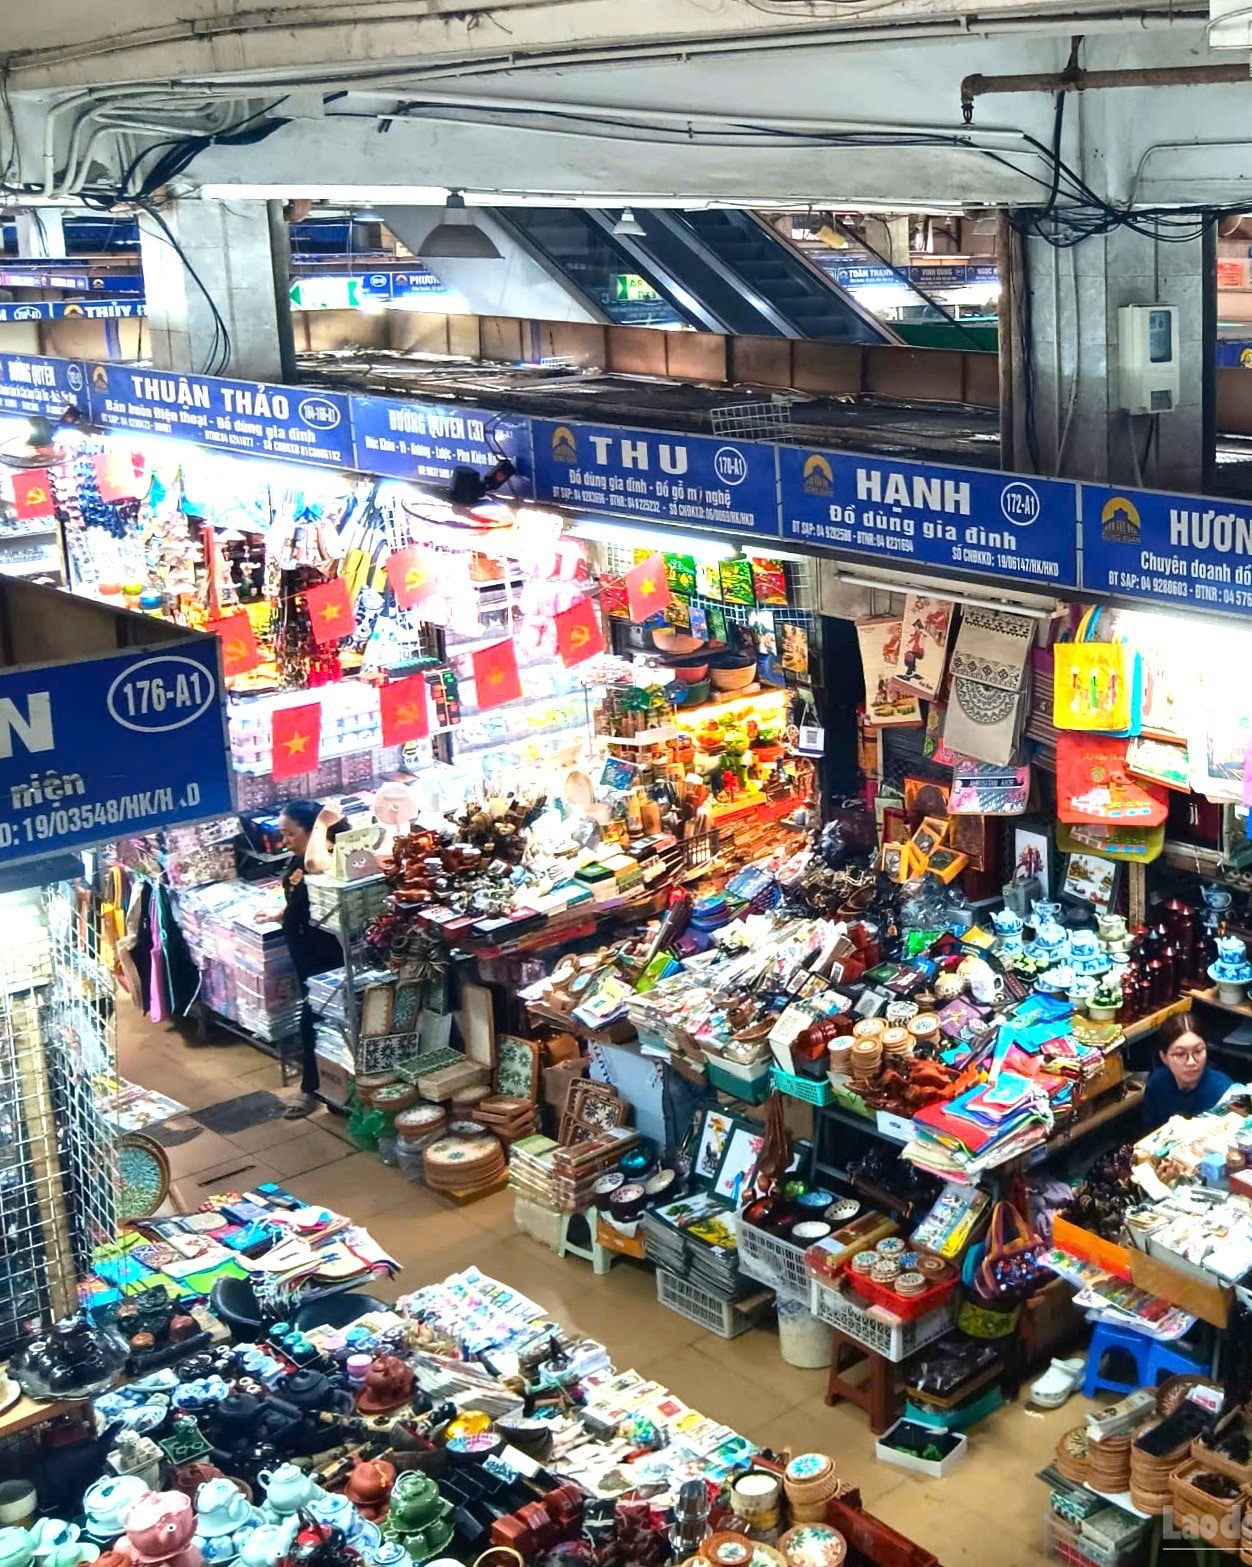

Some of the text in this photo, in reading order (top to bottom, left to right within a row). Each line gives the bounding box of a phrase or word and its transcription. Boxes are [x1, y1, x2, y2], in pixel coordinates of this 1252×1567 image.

[131, 376, 290, 420] THUẬN THẢO
[589, 435, 688, 475] THU
[718, 456, 744, 477] 170-A1
[609, 474, 624, 492] gia
[856, 468, 971, 516] HẠNH
[1006, 493, 1035, 516] 172-A1
[829, 504, 1017, 551] Đồ dùng gia đình
[1141, 551, 1187, 577] Chuyên
[1191, 559, 1231, 584] doanh
[123, 671, 203, 717] 176-A1
